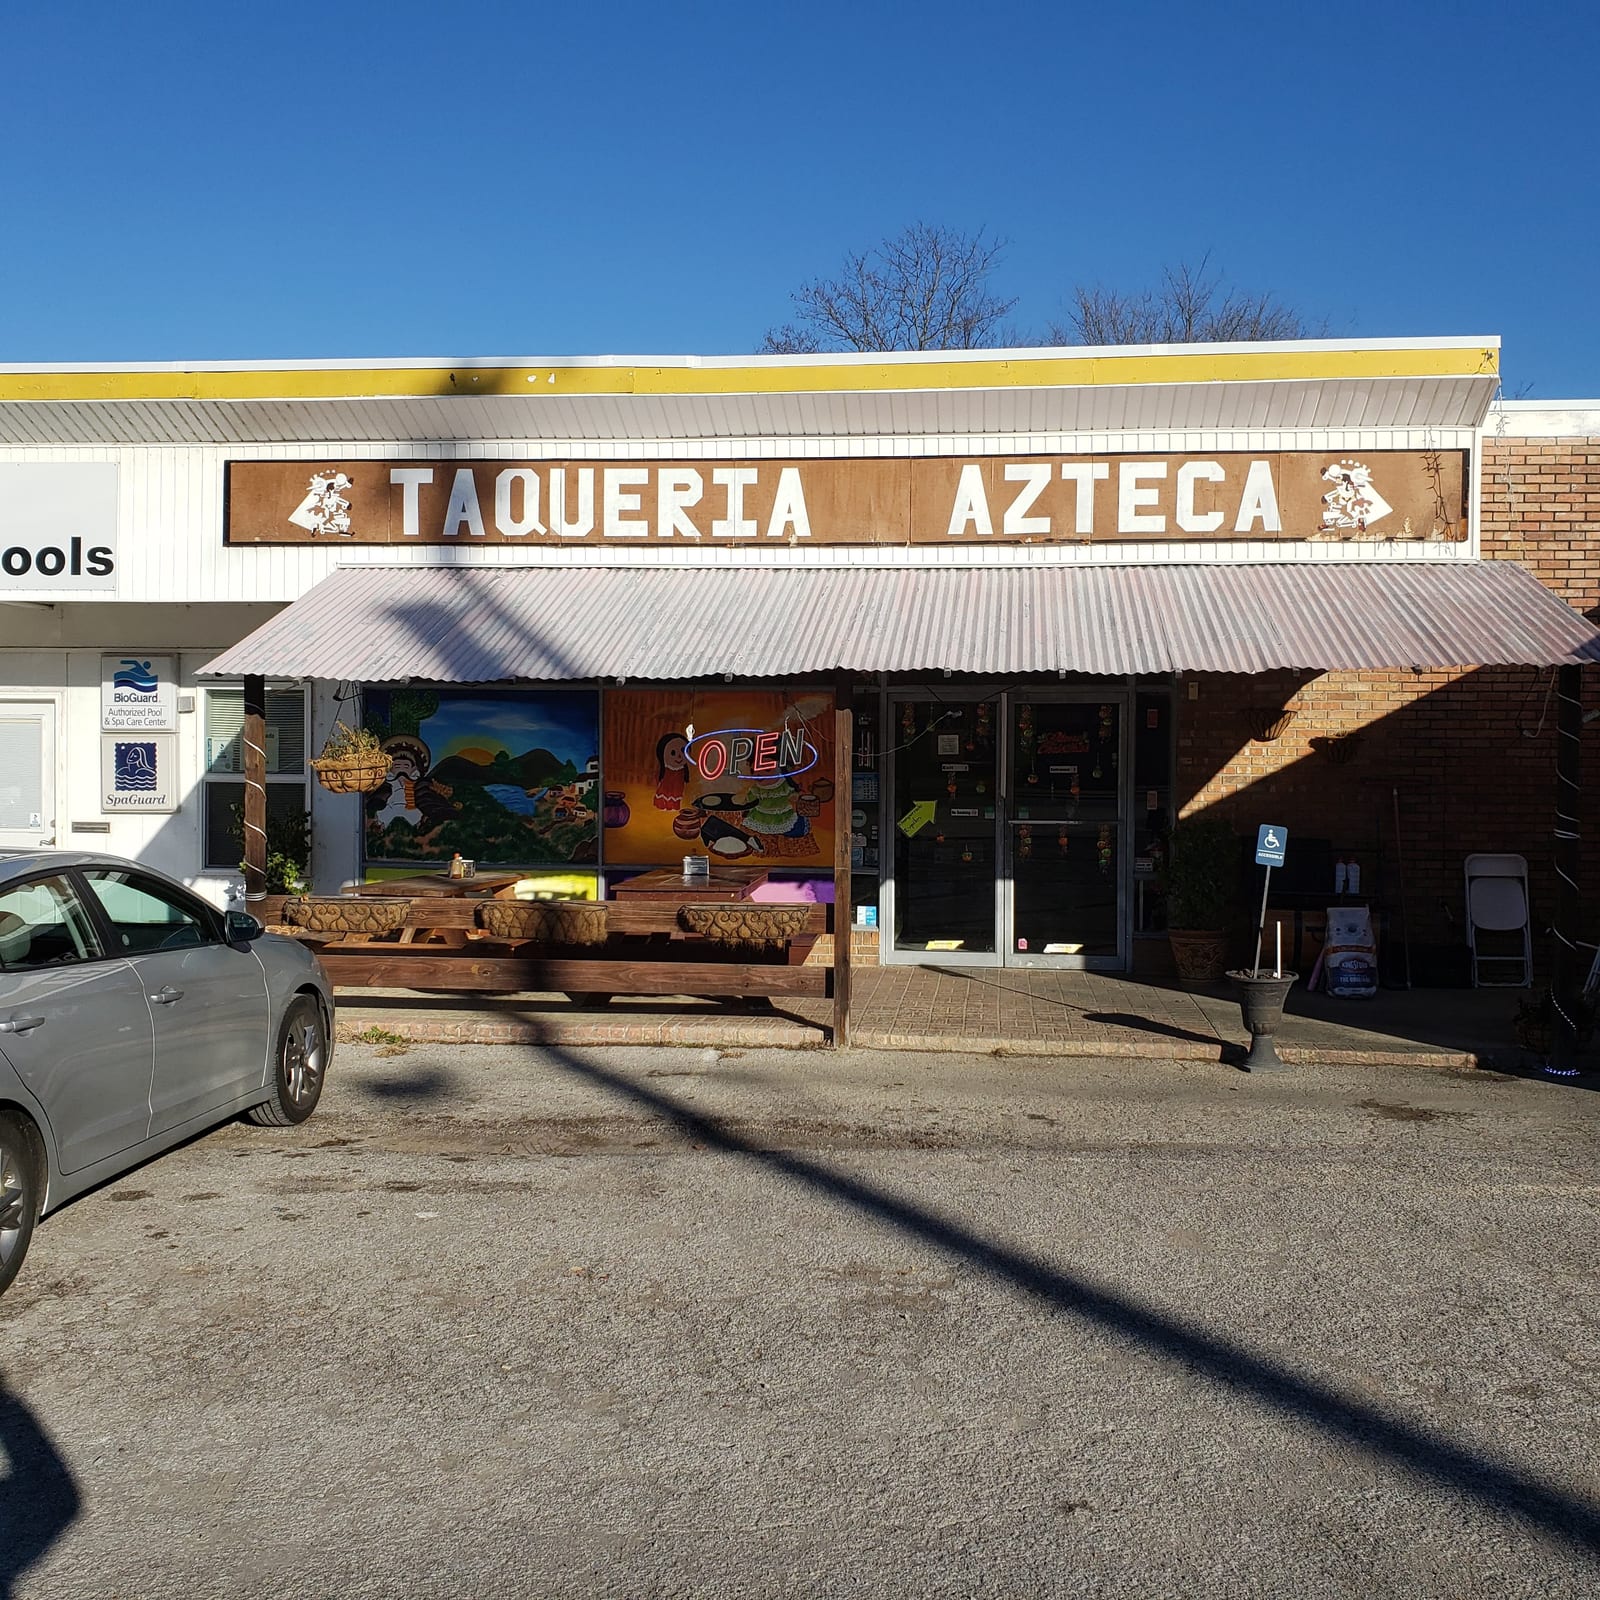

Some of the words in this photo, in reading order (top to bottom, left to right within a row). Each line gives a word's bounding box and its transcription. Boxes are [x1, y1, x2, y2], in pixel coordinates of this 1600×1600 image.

[389, 467, 812, 538] TAQUERIA
[947, 460, 1283, 535] AZTECA
[113, 693, 159, 703] BioGuard
[108, 707, 146, 717] Authorized
[147, 707, 163, 717] Pool
[104, 717, 111, 726] &
[111, 717, 125, 728] Spa
[126, 717, 143, 726] Care
[143, 717, 168, 726] Center
[698, 728, 805, 781] OPEN
[106, 794, 166, 806] SpaGuard
